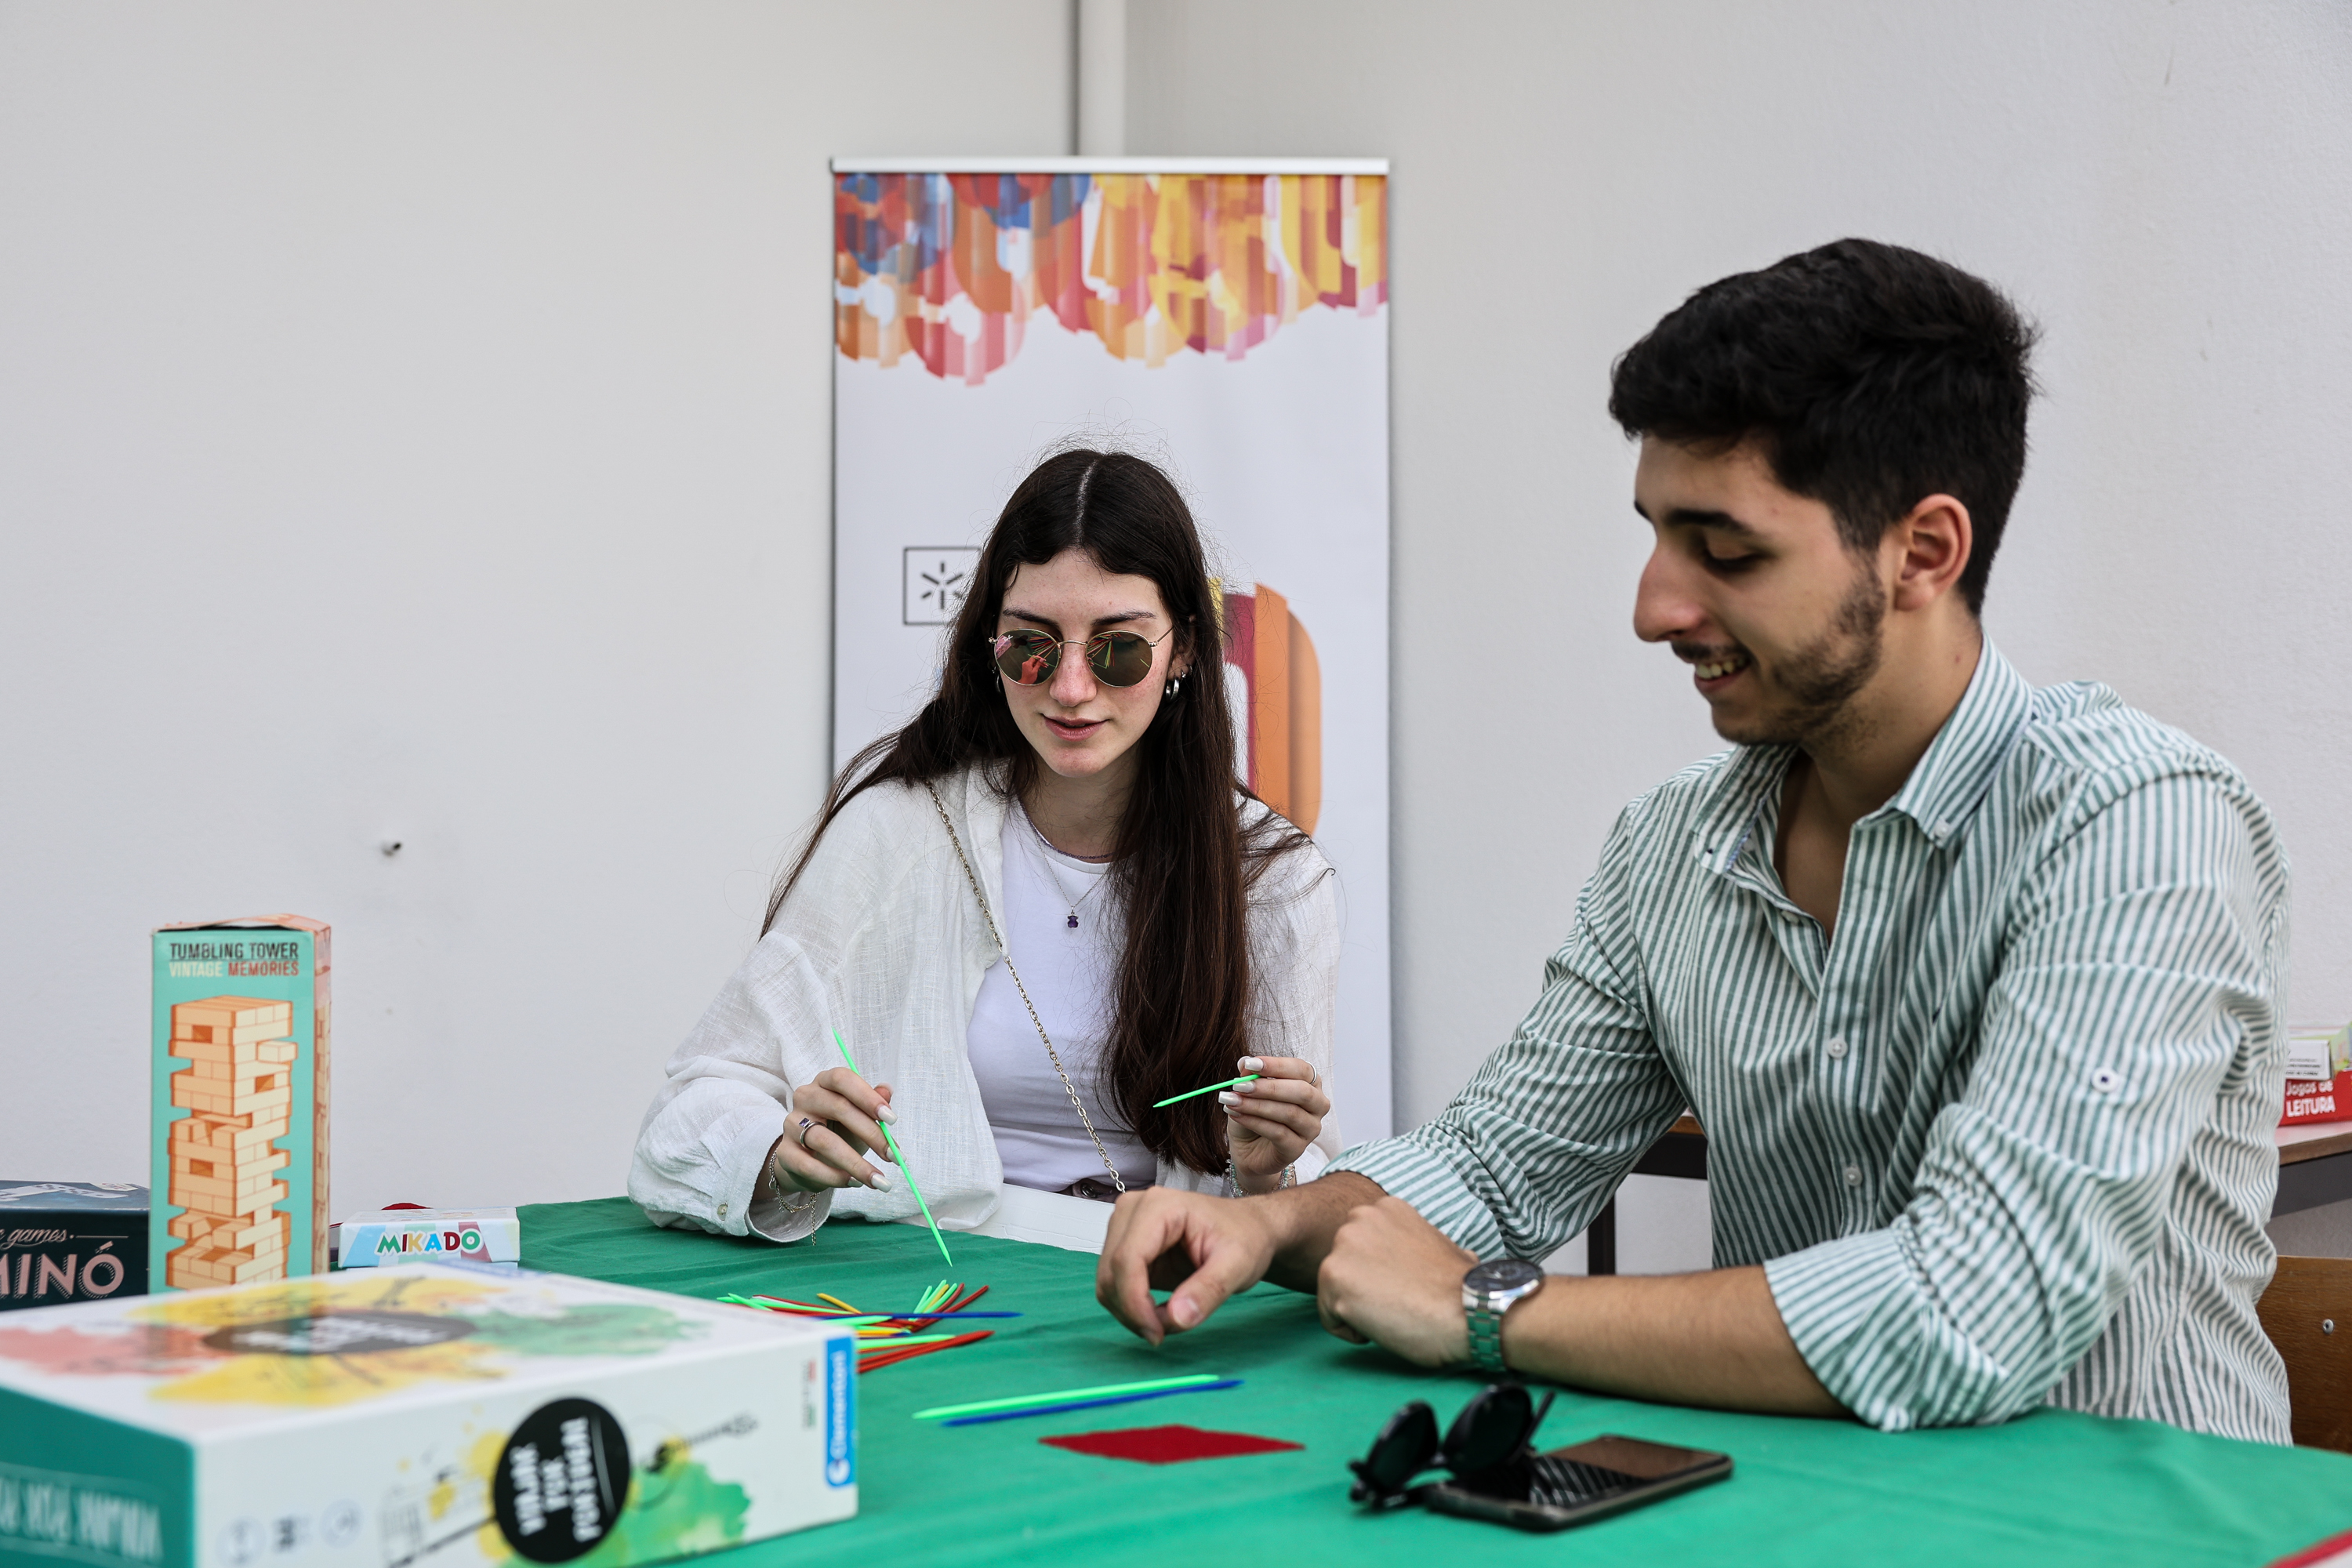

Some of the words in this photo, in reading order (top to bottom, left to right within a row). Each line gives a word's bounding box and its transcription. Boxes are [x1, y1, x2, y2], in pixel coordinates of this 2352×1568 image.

[169, 942, 244, 959] TUMBLING
[249, 942, 299, 959] TOWER
[169, 961, 223, 978] VINTAGE
[228, 960, 299, 977] MEMORIES
[2286, 1095, 2336, 1117] LEITURA
[1, 1229, 67, 1250] games
[376, 1229, 482, 1254] MIKADO
[0, 1240, 125, 1299] INÓ
